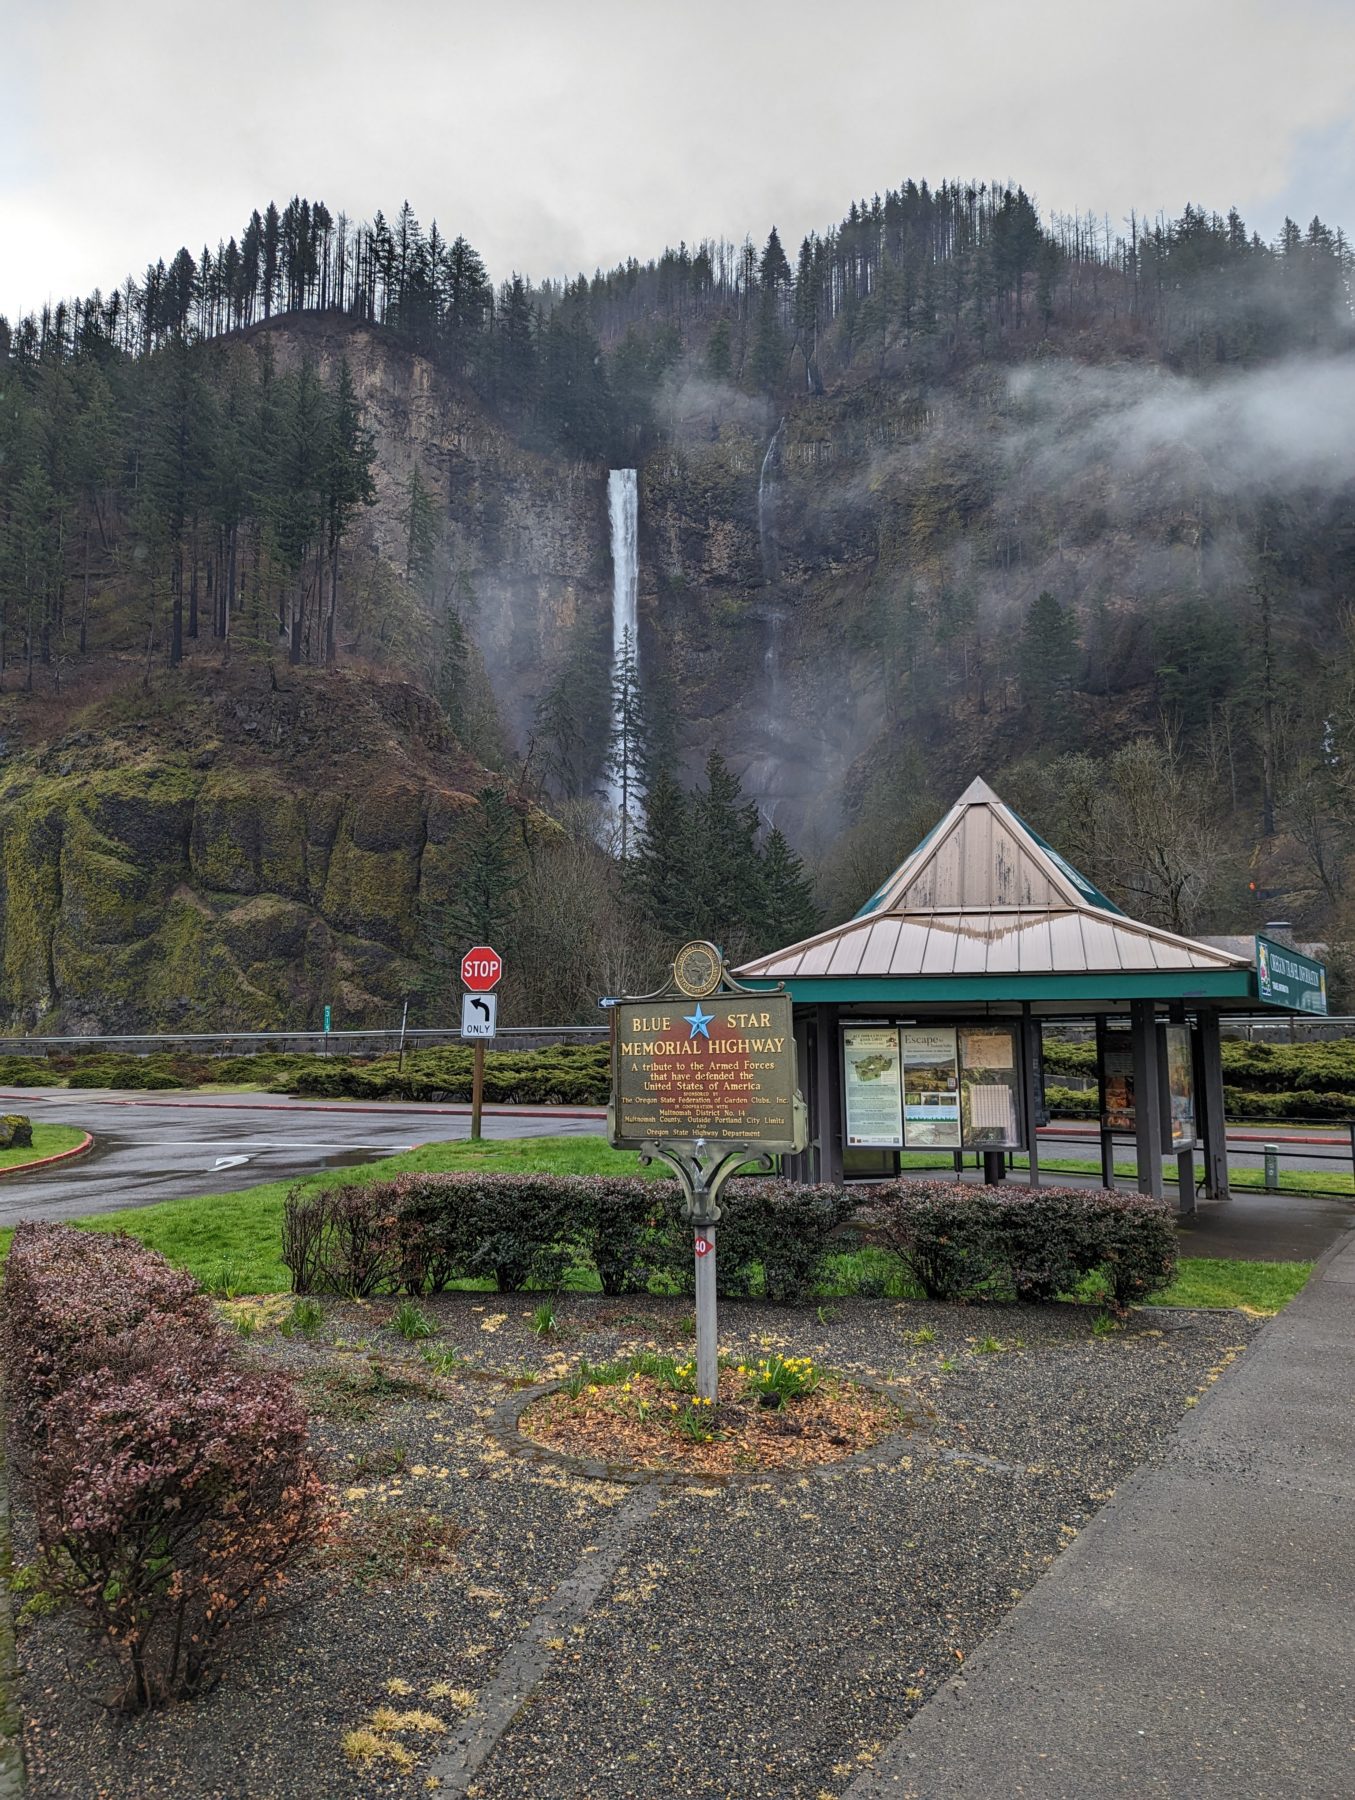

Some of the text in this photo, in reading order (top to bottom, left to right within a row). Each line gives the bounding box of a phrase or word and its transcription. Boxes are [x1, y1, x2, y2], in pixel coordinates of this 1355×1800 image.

[464, 960, 498, 978] STOP
[633, 1014, 771, 1032] BLUE STAR
[467, 1024, 490, 1034] ONLY
[904, 1034, 938, 1046] Escape
[622, 1038, 784, 1056] MEMORIAL HIGHWAY
[642, 1062, 672, 1071] tribute
[676, 1062, 685, 1070] to
[690, 1061, 704, 1070] the
[709, 1062, 739, 1070] Armed
[744, 1061, 775, 1070] Forces
[650, 1071, 754, 1080] that have defended the
[644, 1081, 761, 1091] United States of America
